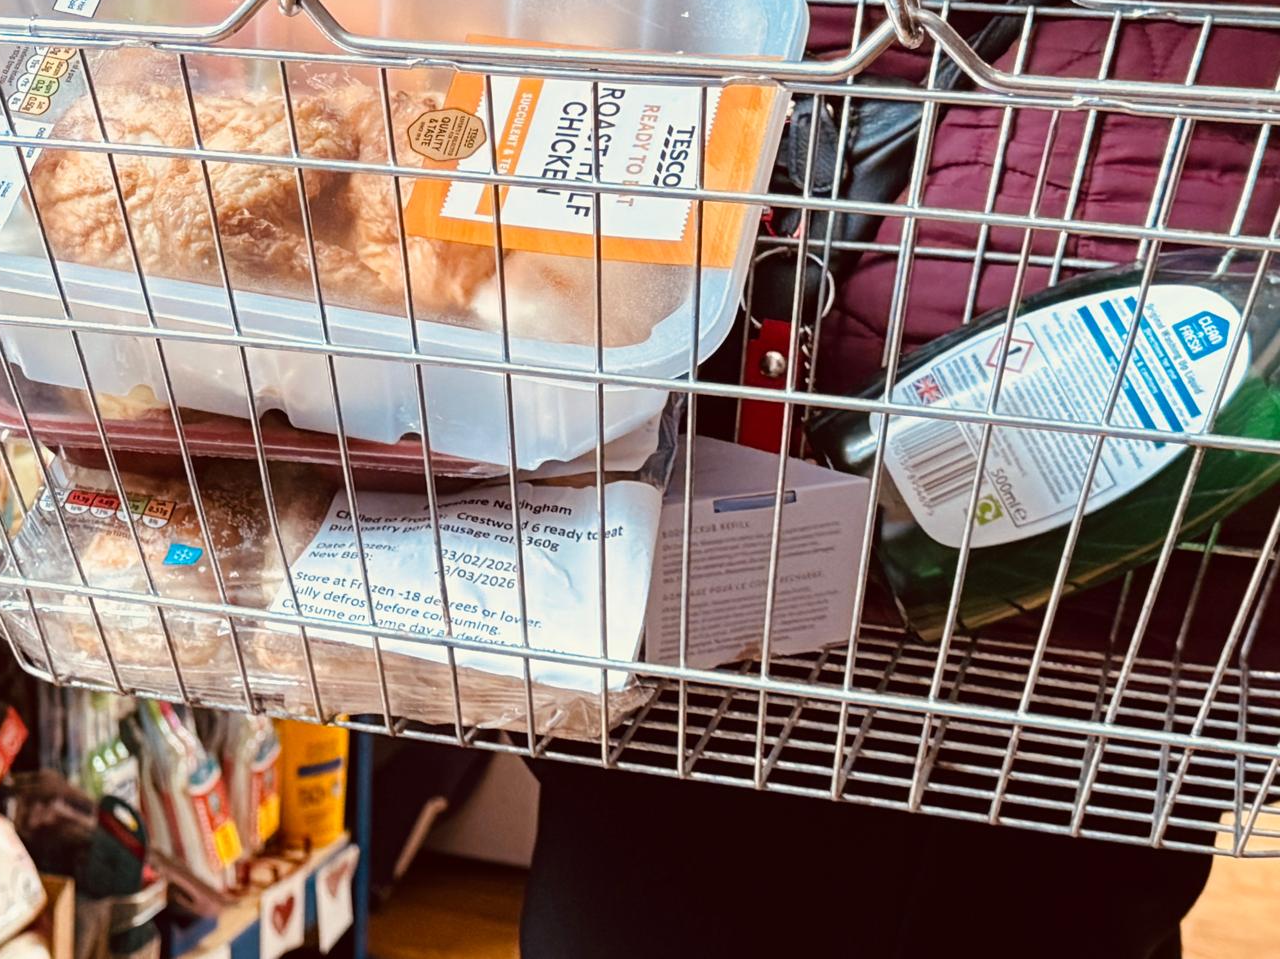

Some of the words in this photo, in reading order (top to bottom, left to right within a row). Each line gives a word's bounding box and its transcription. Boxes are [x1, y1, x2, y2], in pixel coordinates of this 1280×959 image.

[431, 116, 451, 152] QUALITY
[507, 92, 532, 147] SUCCULENT
[584, 85, 626, 157] ROAST
[632, 102, 661, 151] READY
[421, 124, 436, 147] TASTE
[466, 128, 479, 149] TESCO
[625, 152, 647, 177] TO
[661, 122, 696, 191] TESCO
[615, 178, 639, 208] ET
[1181, 325, 1200, 354] FRESH
[1197, 314, 1225, 346] CLEAN
[990, 468, 1020, 510] 500ml
[493, 498, 573, 517] Noingham
[329, 524, 357, 534] puf
[361, 523, 400, 534] pastry
[526, 538, 560, 553] 360g
[337, 509, 381, 524] Chlled
[457, 511, 530, 530] Crestwod
[532, 523, 540, 533] 6
[543, 523, 583, 543] ready
[309, 550, 338, 559] New
[316, 541, 346, 550] Date
[350, 542, 397, 552] Fozen:
[434, 565, 516, 589] 3/03/2026
[294, 585, 320, 599] ully
[323, 591, 368, 608] defros
[376, 600, 419, 617] before
[295, 571, 330, 584] Store
[333, 577, 346, 587] at
[350, 579, 394, 597] Frzen
[398, 590, 421, 601] -18
[424, 594, 485, 613] derees
[482, 608, 497, 618] or
[349, 613, 366, 622] on
[376, 618, 406, 631] ame
